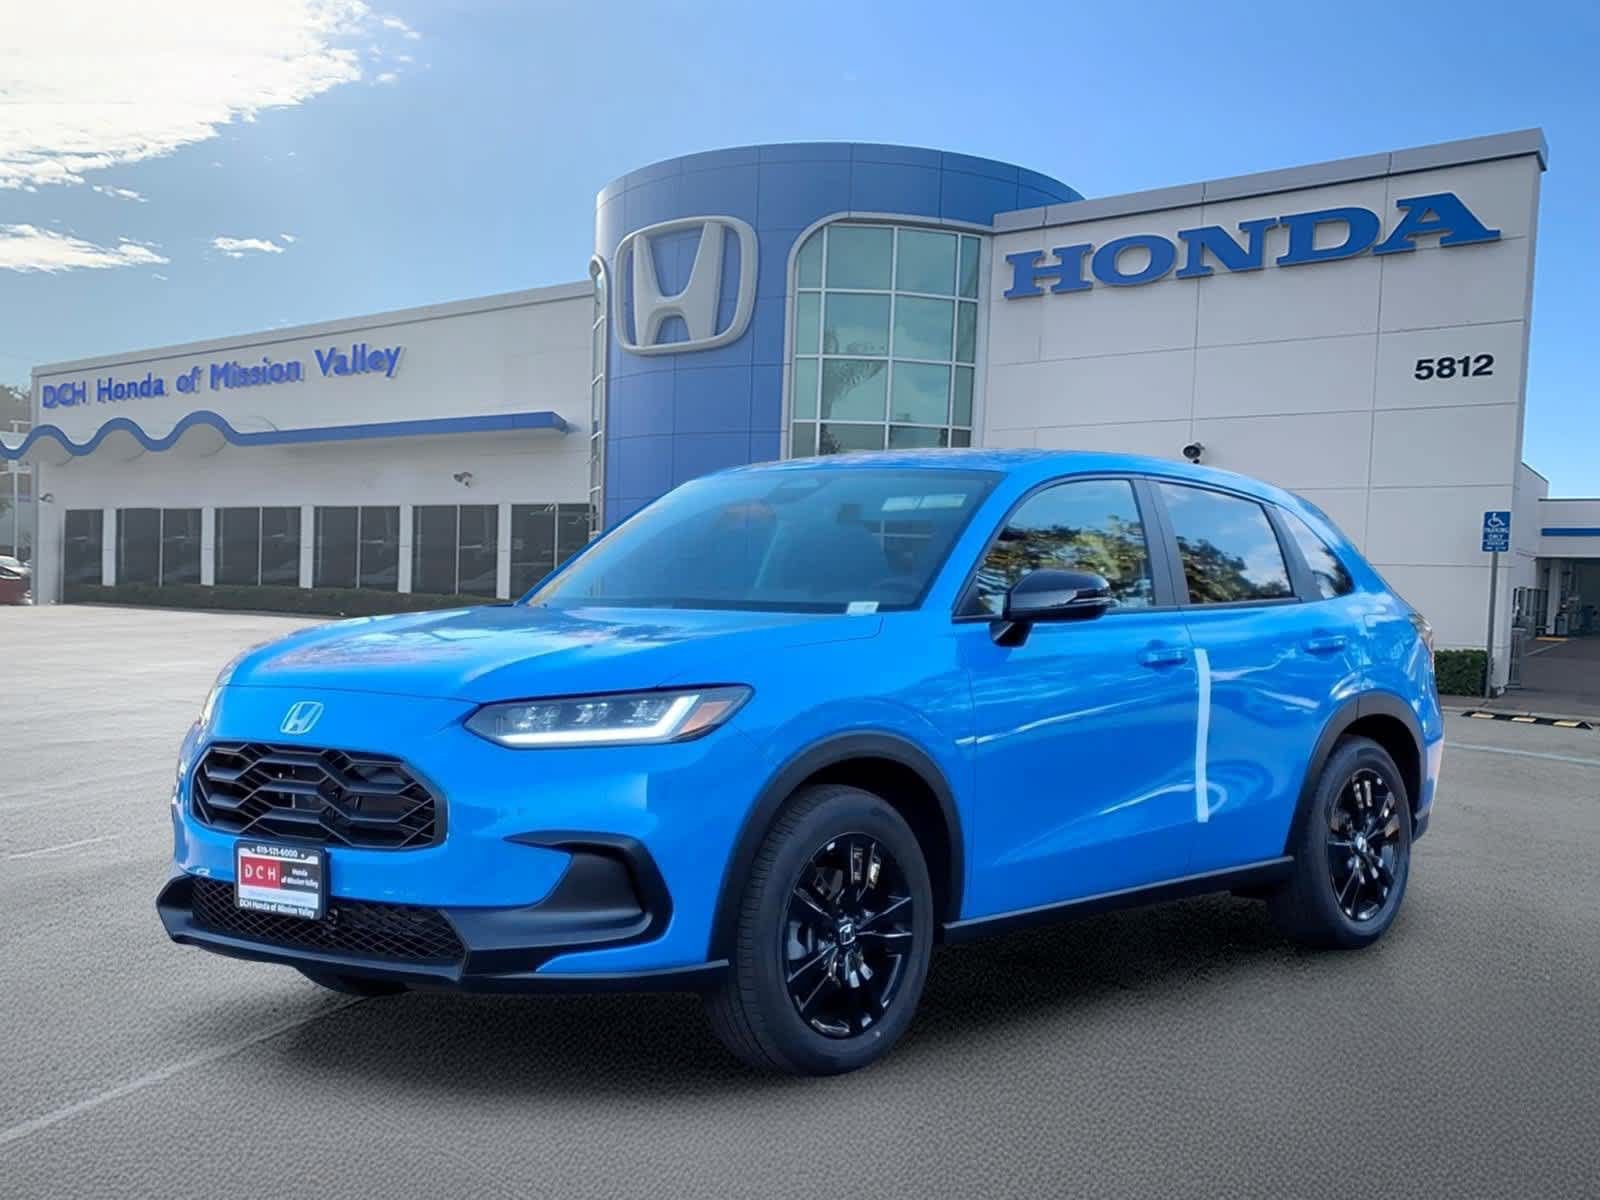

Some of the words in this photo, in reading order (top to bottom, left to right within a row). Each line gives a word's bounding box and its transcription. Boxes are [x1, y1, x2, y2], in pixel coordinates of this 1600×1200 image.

[1004, 192, 1501, 299] HONDA
[42, 381, 87, 409] DCH
[97, 372, 165, 403] Honda
[176, 366, 202, 393] of
[210, 356, 302, 390] Mission
[313, 343, 401, 378] Valley
[1414, 354, 1494, 380] 5812
[253, 901, 270, 911] Honda
[270, 903, 278, 912] of
[278, 904, 297, 915] Mission
[298, 907, 314, 919] Valley
